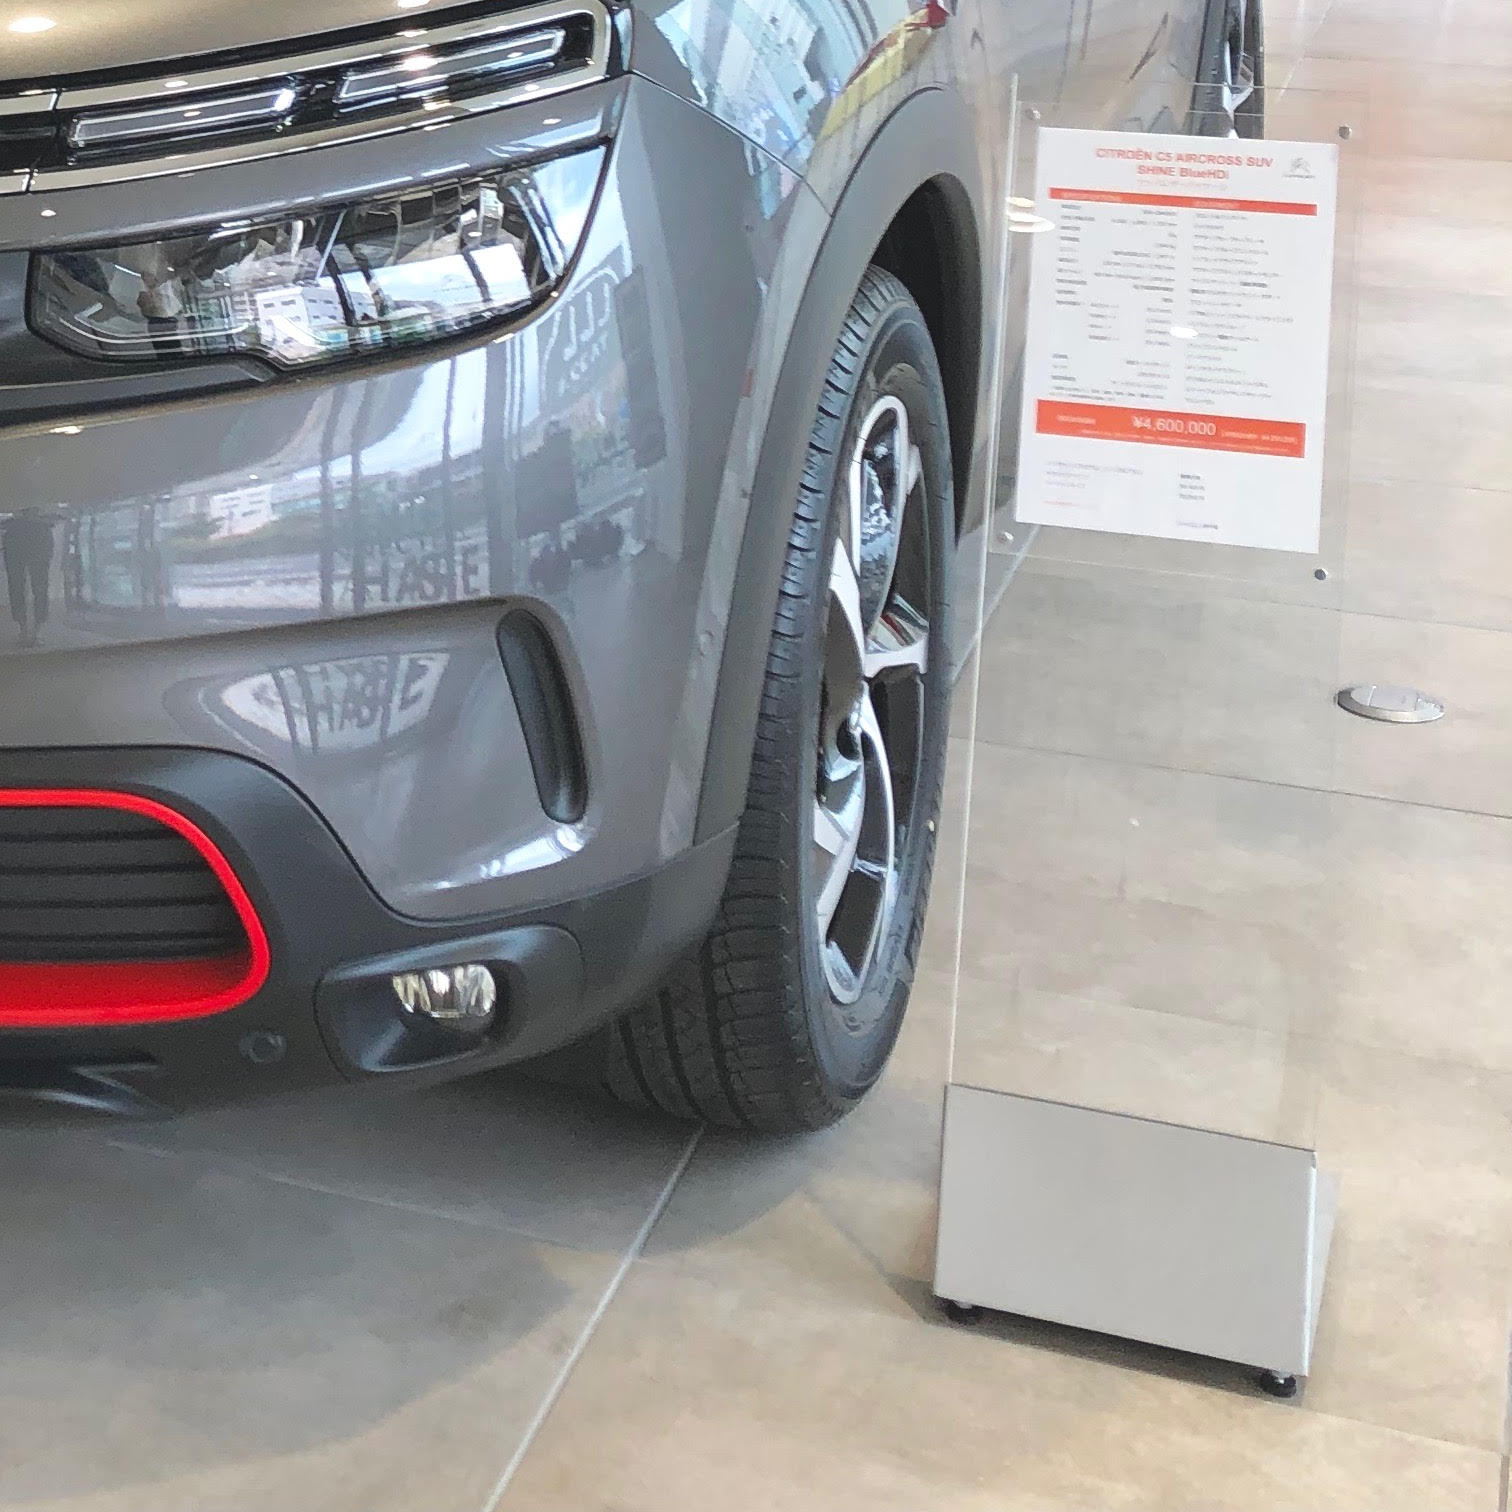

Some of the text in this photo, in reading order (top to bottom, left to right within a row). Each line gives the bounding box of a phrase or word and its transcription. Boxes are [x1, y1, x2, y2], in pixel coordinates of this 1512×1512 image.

[1157, 151, 1172, 162] C5
[1176, 152, 1242, 166] AIRCROSS
[1246, 156, 1273, 167] SUV
[1137, 164, 1229, 179] SHINE BlueHDi
